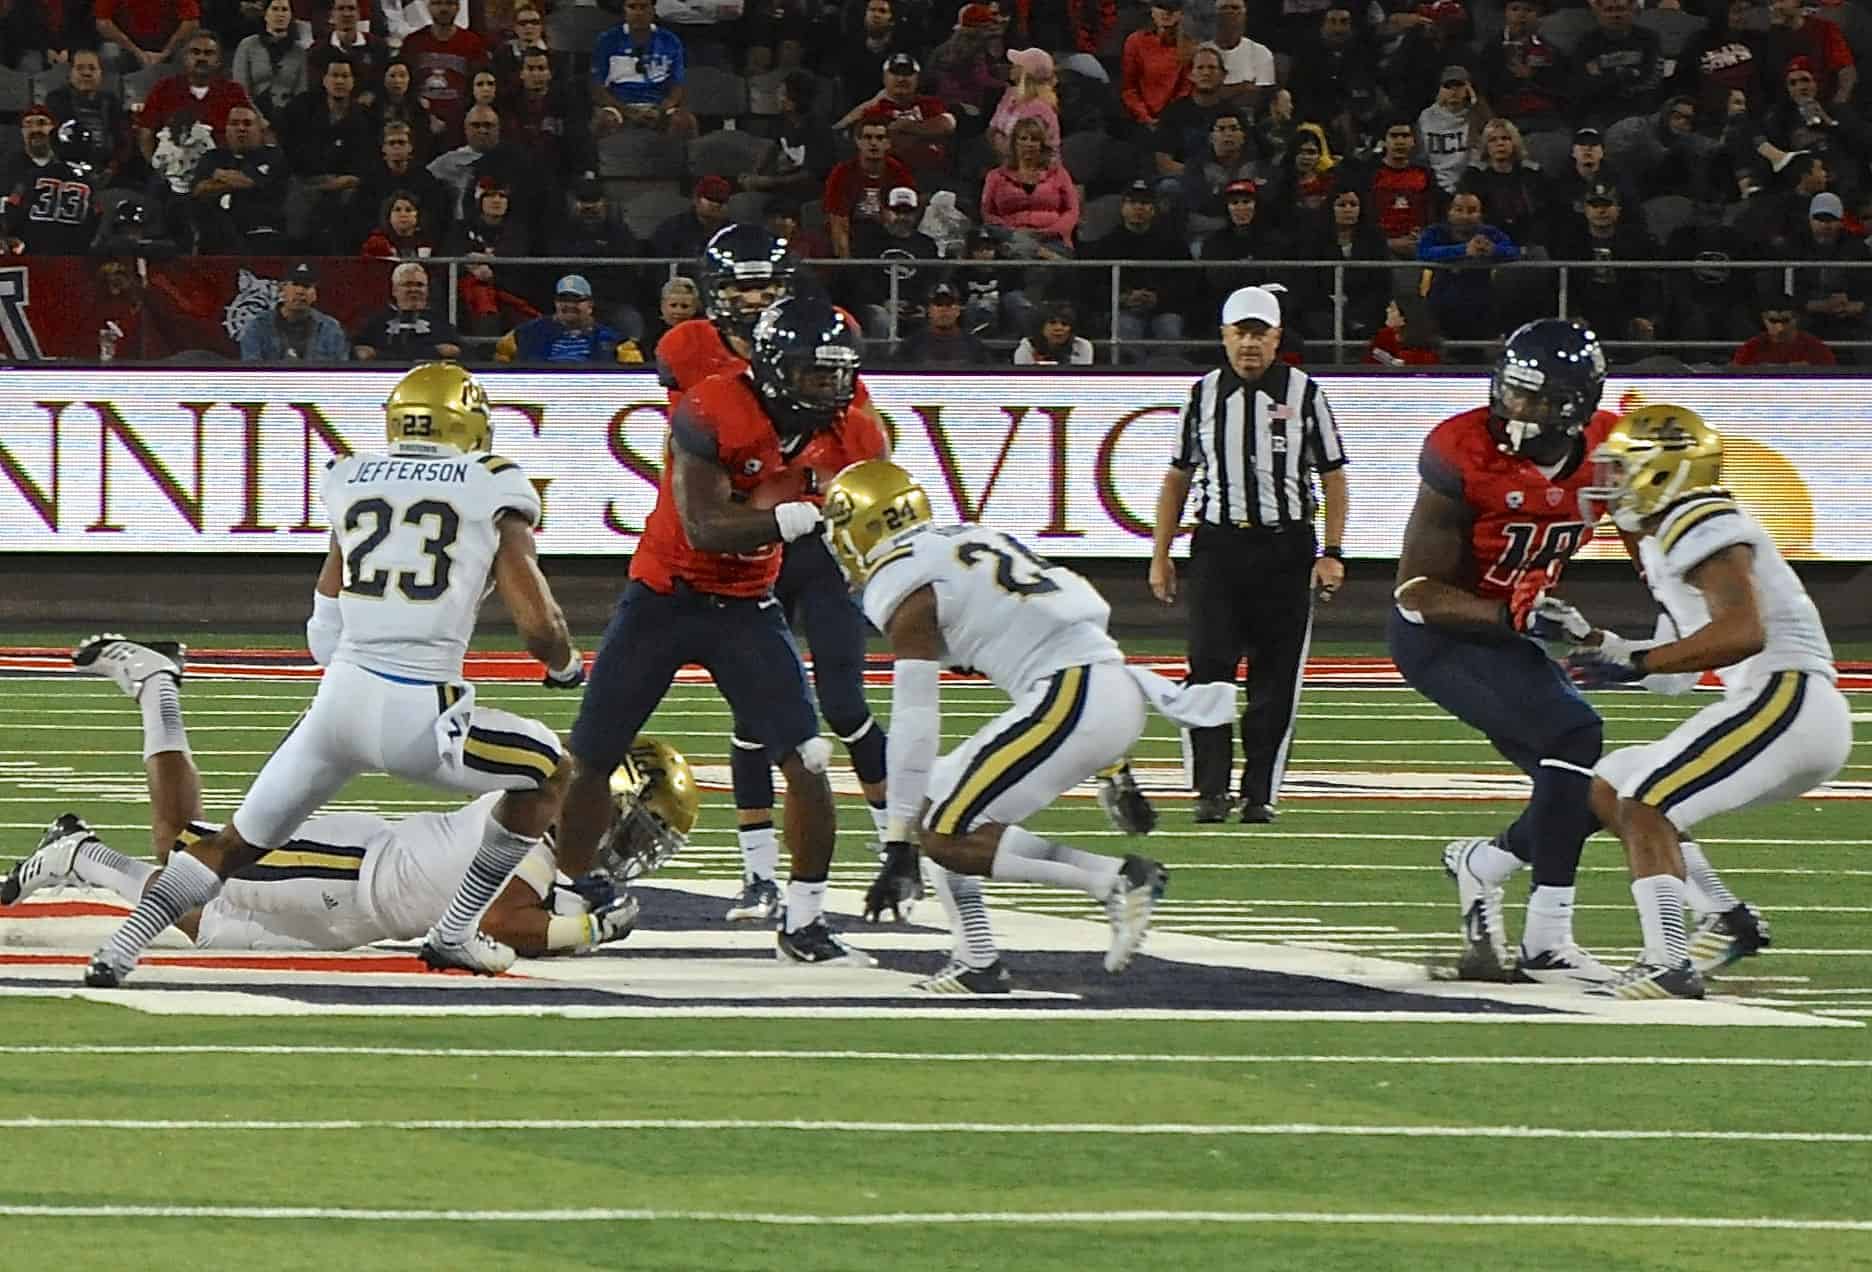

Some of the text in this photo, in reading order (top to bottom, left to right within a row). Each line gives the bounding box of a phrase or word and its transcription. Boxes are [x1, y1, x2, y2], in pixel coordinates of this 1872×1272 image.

[1427, 131, 1469, 155] UCL
[29, 177, 92, 224] 33
[403, 413, 432, 437] 23
[348, 461, 468, 484] JEFFERSON
[883, 499, 918, 531] 24
[343, 496, 460, 602] 23
